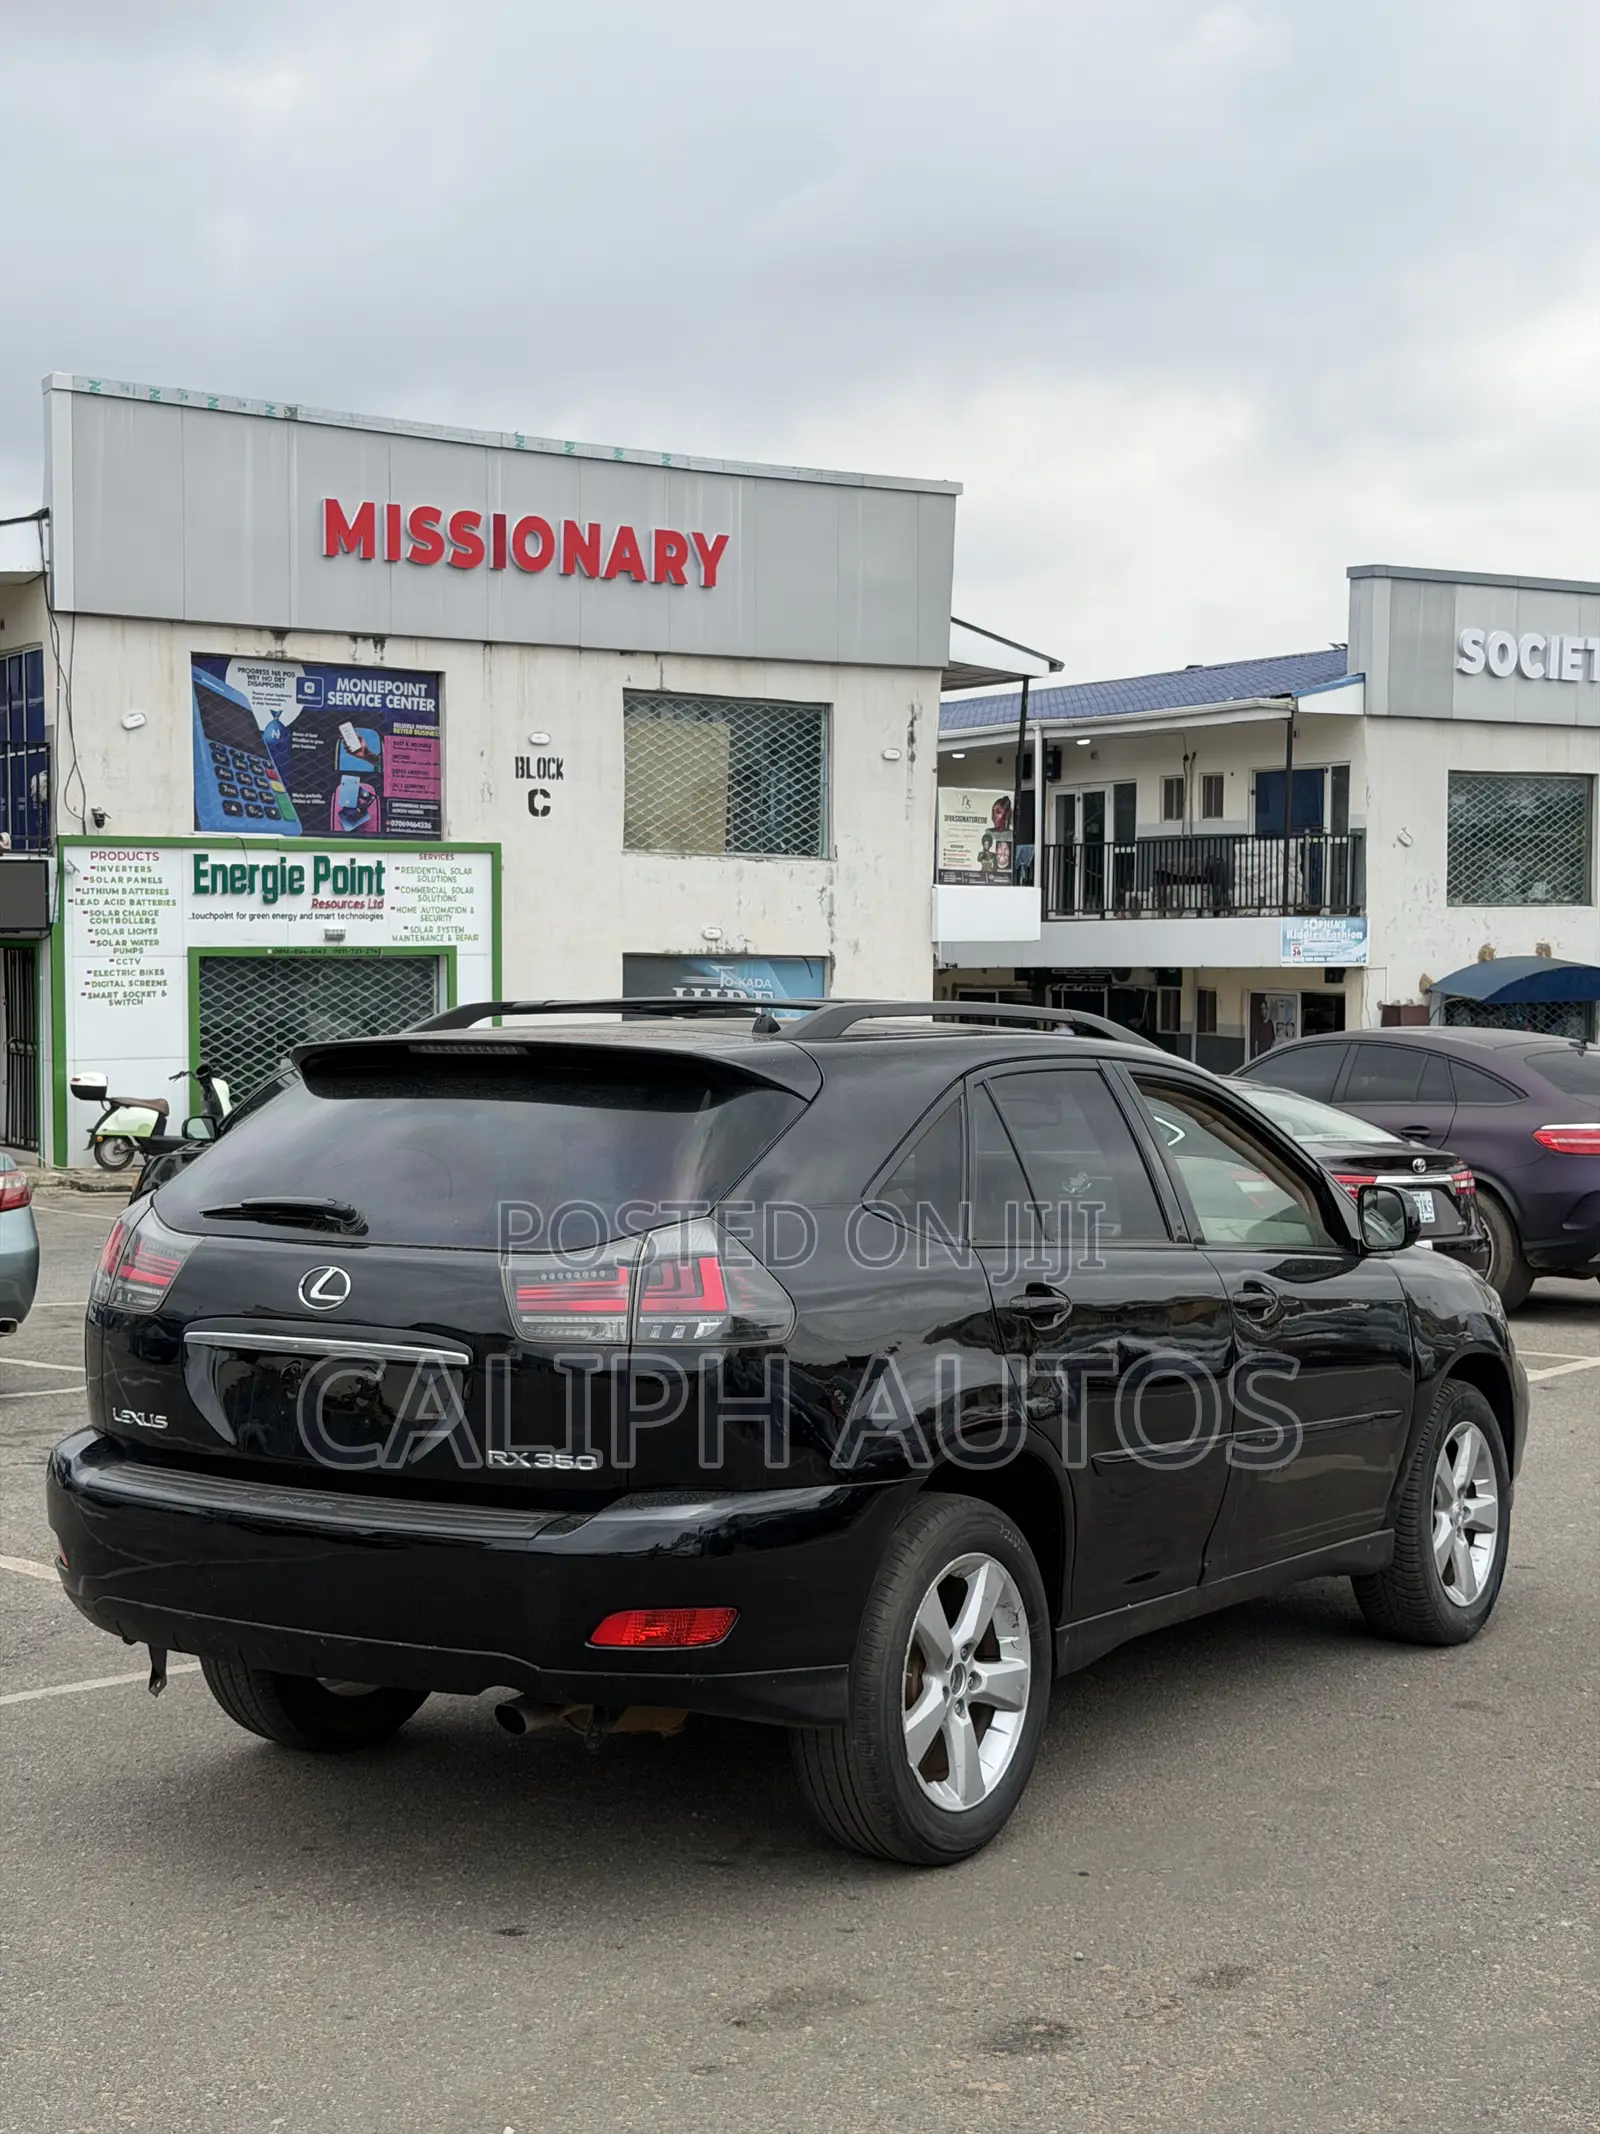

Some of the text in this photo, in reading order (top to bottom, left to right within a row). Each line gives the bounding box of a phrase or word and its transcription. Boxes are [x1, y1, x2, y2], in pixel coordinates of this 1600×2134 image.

[322, 498, 730, 588] MISSIONARY
[238, 667, 270, 676] PROGRESS
[247, 681, 285, 689] DISAPPOINT
[336, 678, 427, 697] MONIEPOINT
[327, 691, 436, 712] SERVICE CENTER
[514, 755, 565, 781] BLOCK
[527, 788, 552, 818] C
[90, 851, 160, 862] PRODUCTS
[419, 853, 455, 861] SERVICES
[96, 865, 153, 873] INVERTERS
[450, 867, 473, 875] SOLAR
[89, 876, 124, 884] SOLAR
[192, 853, 386, 904] Energie Point
[417, 875, 457, 883] SOLUTIONS
[121, 888, 170, 896] BATTERIES
[400, 886, 448, 894] COMMERCIAL
[129, 899, 177, 907] BATTERIES
[311, 898, 384, 910] Resources Ltd
[122, 909, 160, 917] CHARGE
[396, 906, 417, 914] HOME
[420, 906, 467, 914] AUTOMATION
[89, 917, 157, 925] CONTROLLERS
[235, 912, 247, 920] for
[248, 914, 271, 923] green
[271, 914, 298, 923] energy
[299, 912, 314, 920] and
[314, 912, 336, 920] smart
[337, 912, 385, 922] technologies
[420, 914, 453, 922] SECURITY
[94, 928, 158, 936] SOLAR LIGHTS
[392, 934, 445, 942] MAINTENANCE
[96, 940, 128, 948] SOLAR
[113, 947, 144, 955] PUMPS
[93, 969, 137, 977] ELECTRIC
[87, 991, 119, 999] SMART
[122, 990, 157, 998] SOCKET
[108, 998, 144, 1006] SWITCH
[112, 1407, 169, 1429] LEXUS
[488, 1450, 598, 1470] RX 350
